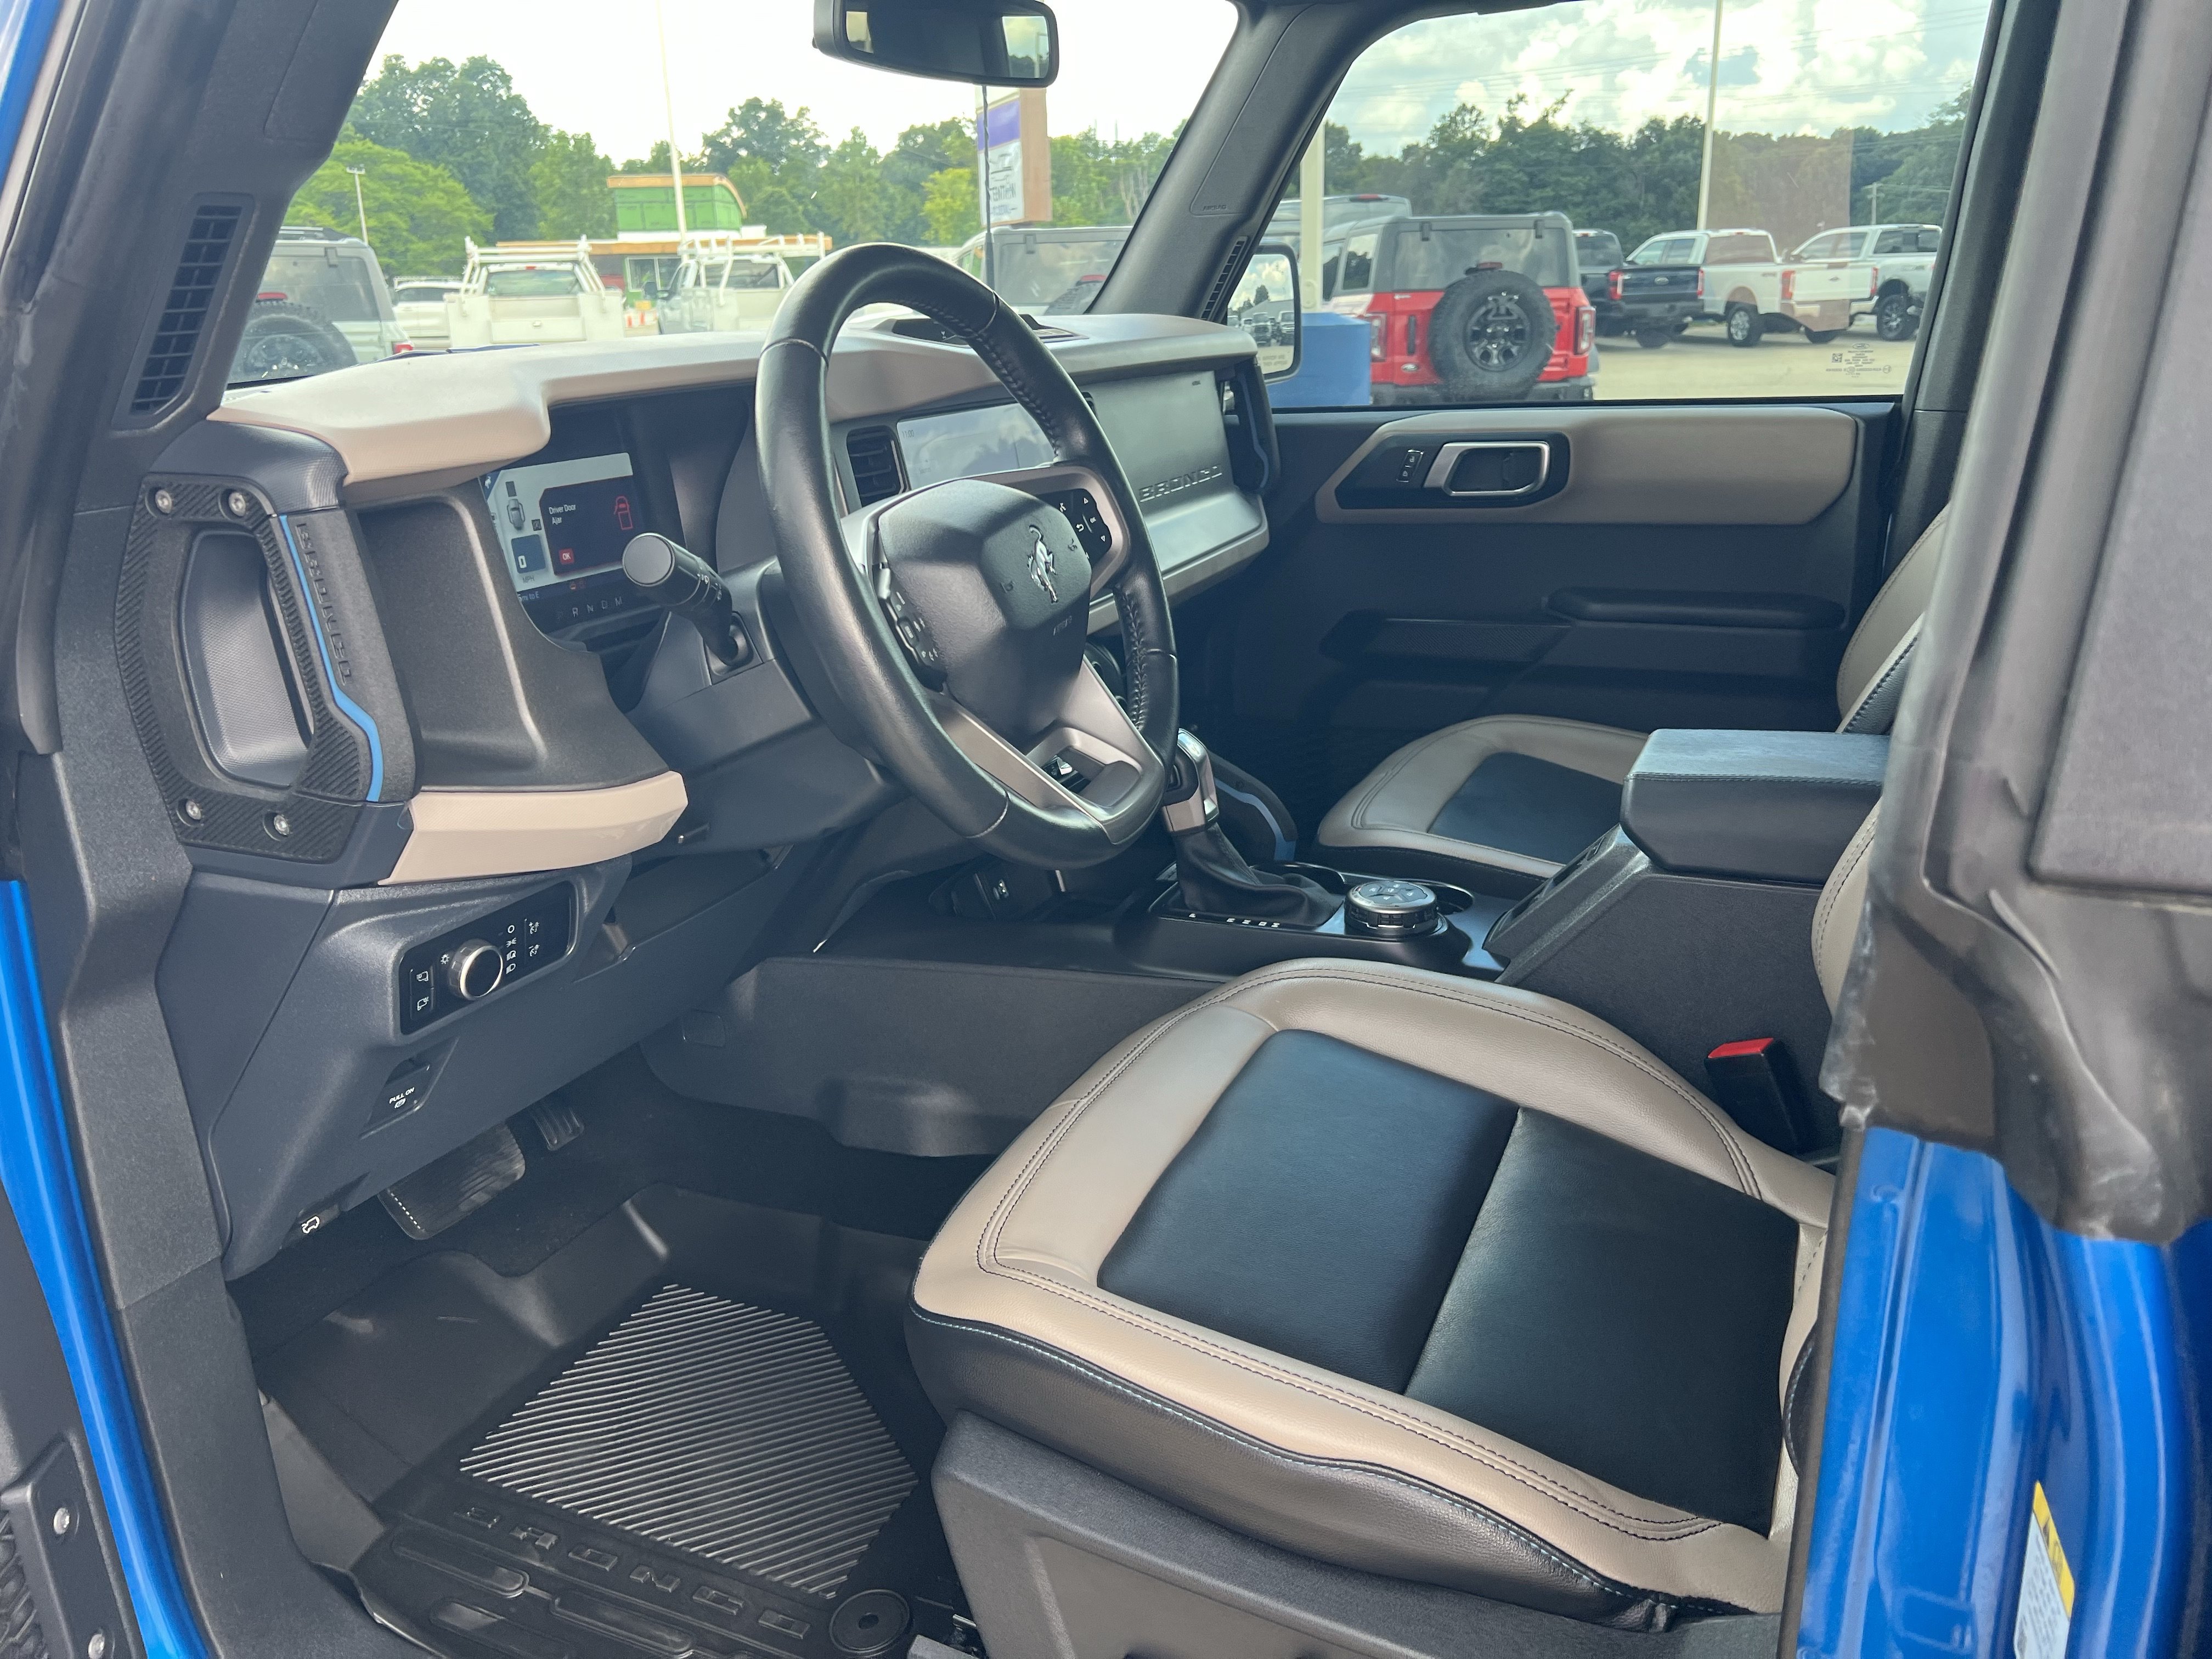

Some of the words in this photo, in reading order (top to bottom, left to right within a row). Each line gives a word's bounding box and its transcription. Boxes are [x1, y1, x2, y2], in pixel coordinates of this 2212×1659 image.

[1138, 464, 1223, 503] BRONCO
[549, 506, 564, 515] Driver
[563, 504, 576, 512] Door
[517, 555, 527, 569] 0
[562, 552, 571, 561] OK
[295, 522, 352, 686] BRONCO
[389, 1093, 405, 1104] PULL
[405, 1087, 415, 1096] ON
[454, 1506, 811, 1639] BRONCO
